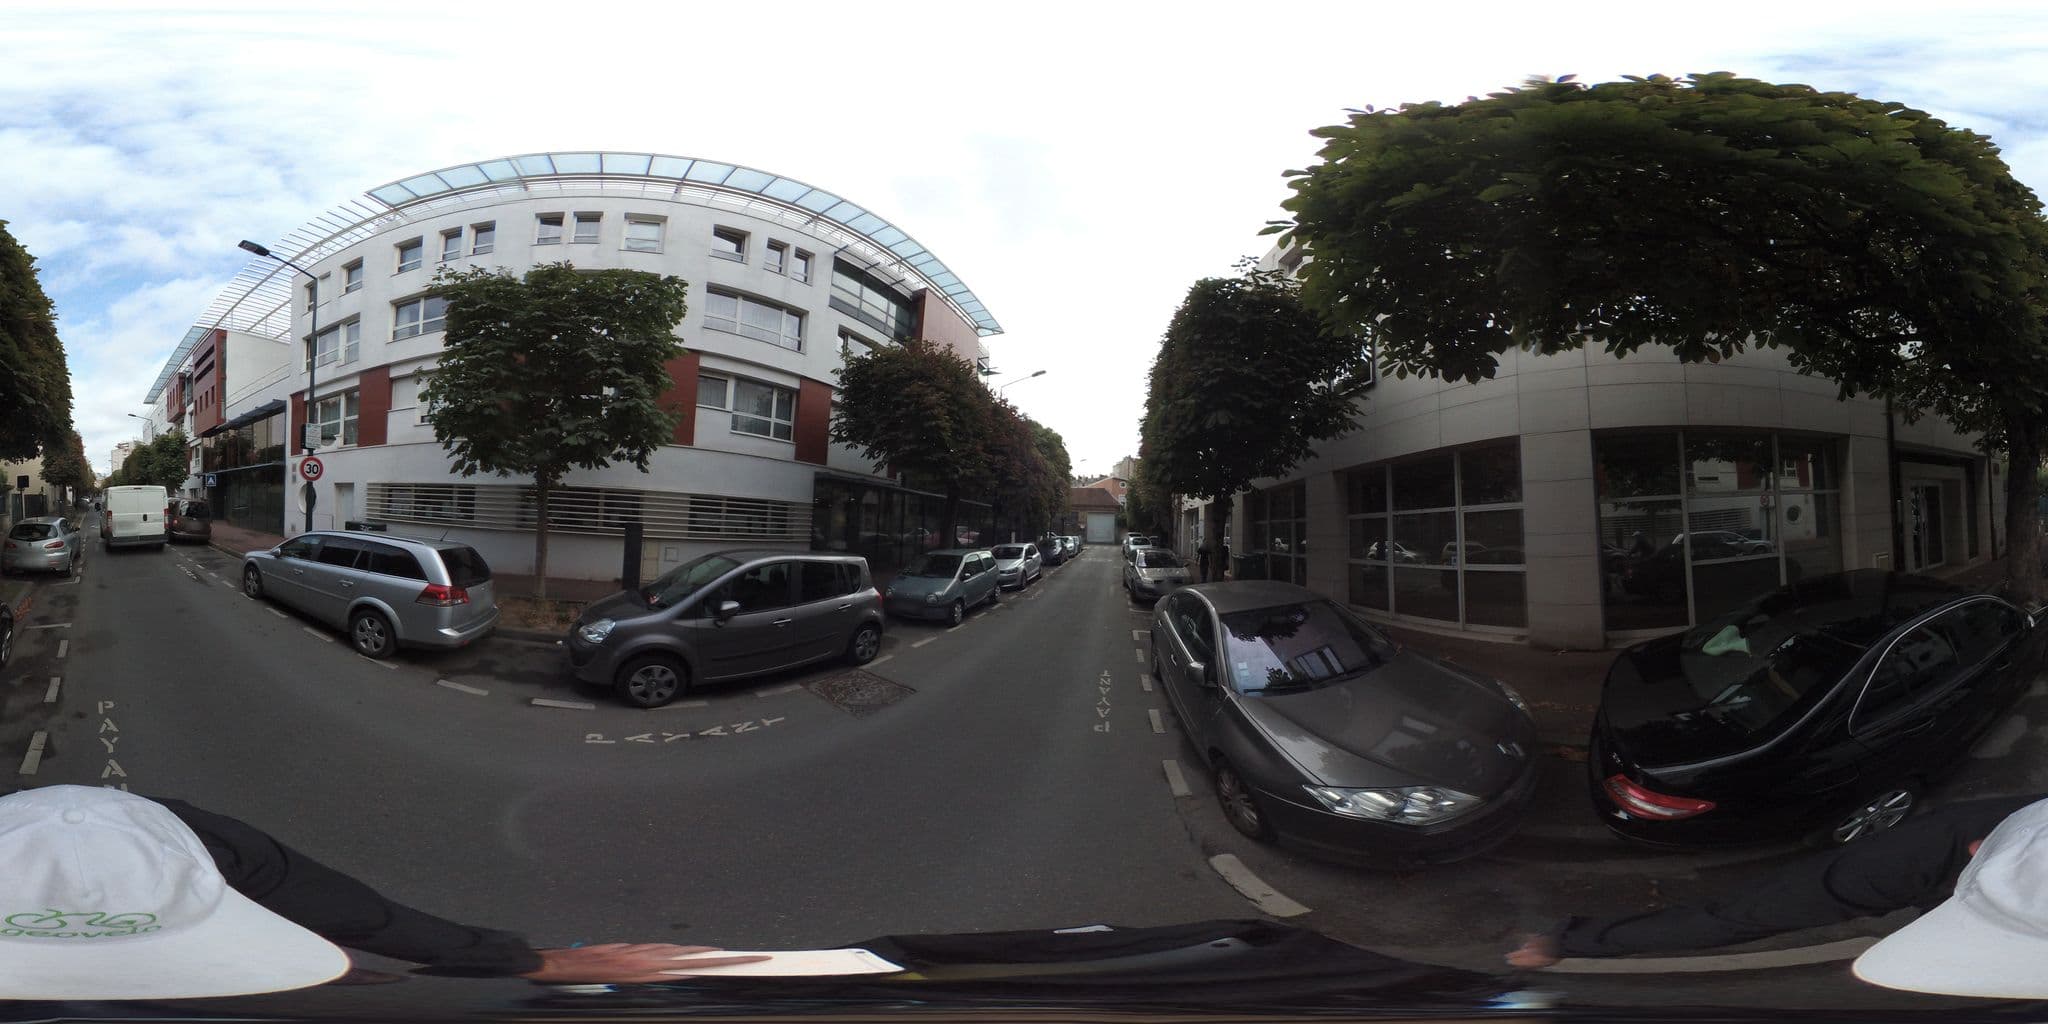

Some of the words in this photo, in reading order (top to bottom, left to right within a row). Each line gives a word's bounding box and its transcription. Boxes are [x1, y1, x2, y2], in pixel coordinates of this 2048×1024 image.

[305, 463, 319, 475] 30
[1093, 669, 1112, 733] PAYANT
[97, 700, 128, 791] PAYA
[584, 716, 786, 744] PAYANT
